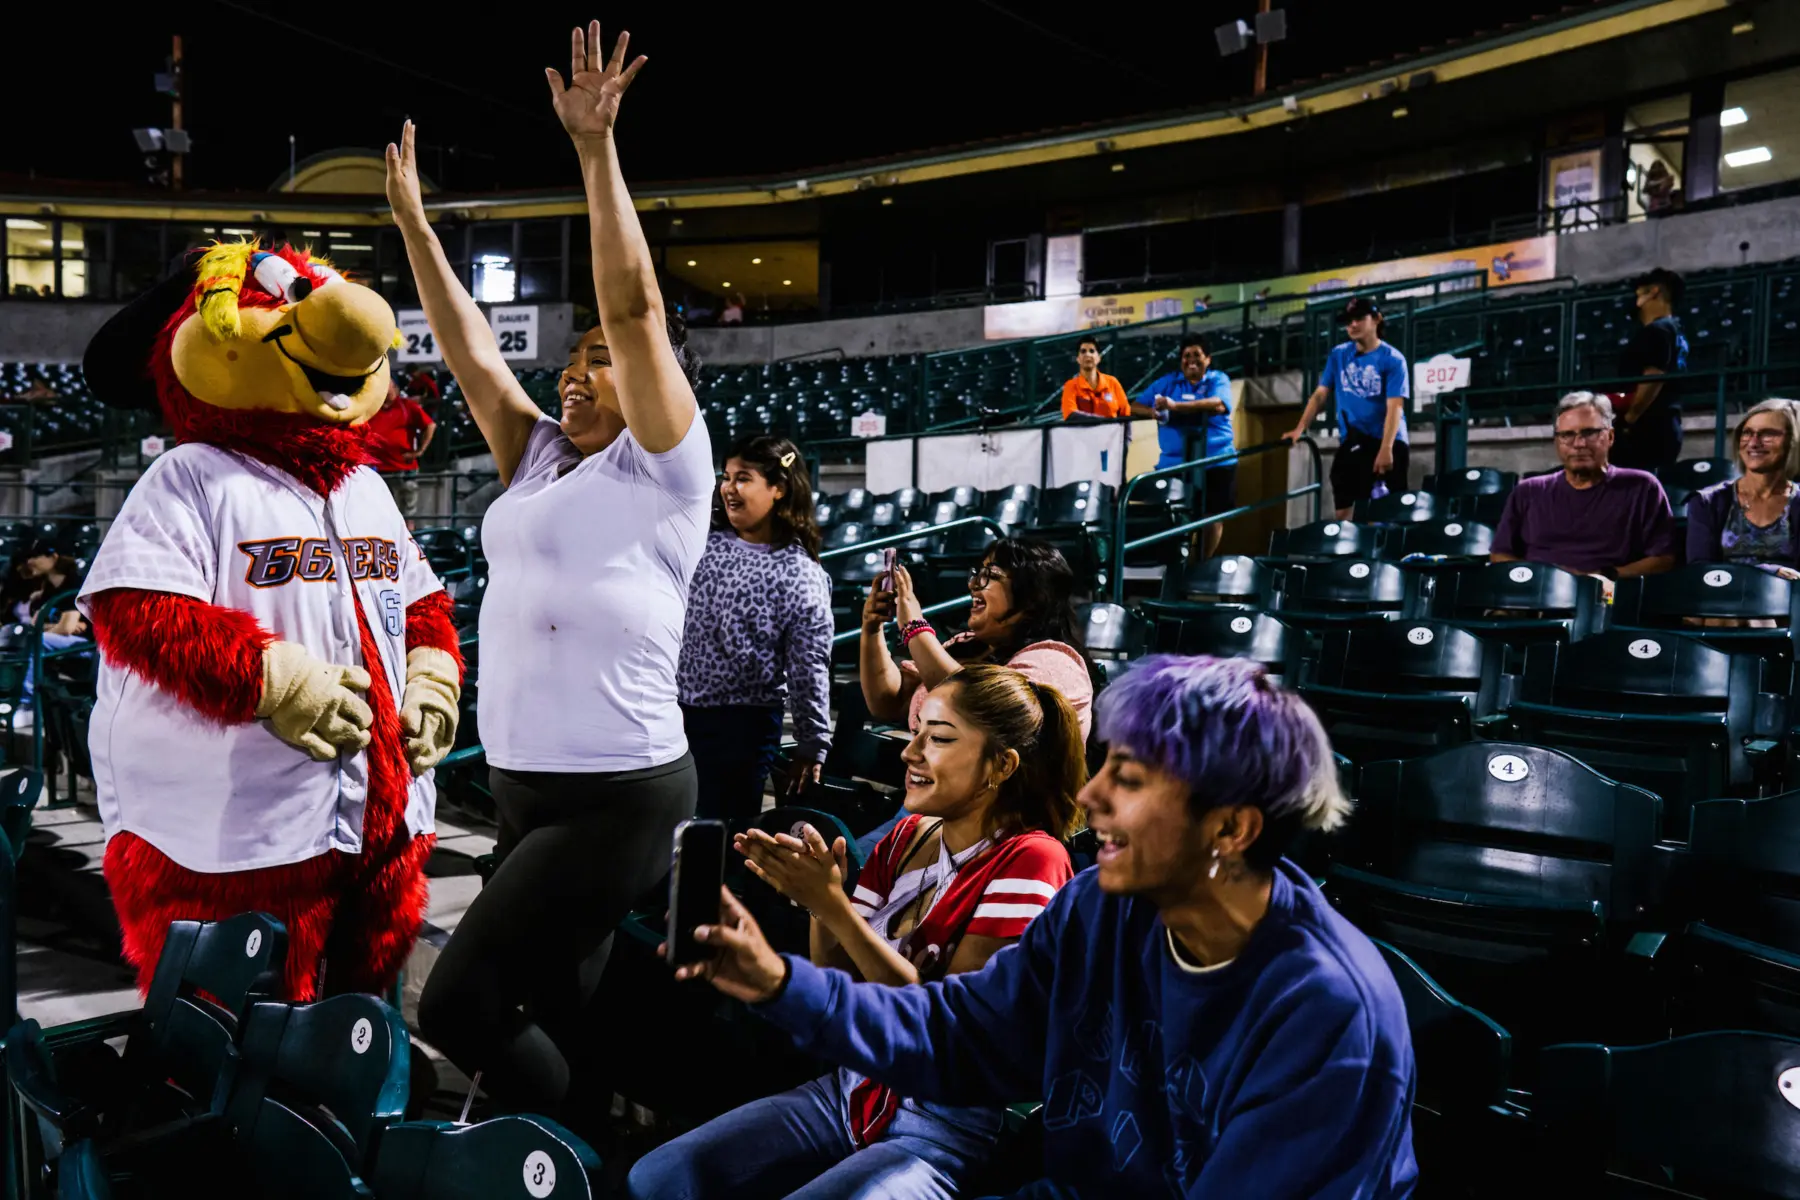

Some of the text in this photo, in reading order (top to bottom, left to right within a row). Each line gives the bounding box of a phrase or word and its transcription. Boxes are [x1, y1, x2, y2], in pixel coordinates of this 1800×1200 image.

[407, 333, 434, 354] 24
[500, 330, 527, 352] 25
[1426, 367, 1458, 383] 207
[238, 536, 399, 589] 66ERS
[1713, 574, 1721, 583] 4
[1416, 632, 1425, 641] 3
[1640, 644, 1650, 654] 4
[1502, 762, 1515, 775] 4
[250, 936, 258, 951] 1
[357, 1026, 366, 1045] 2
[533, 1162, 546, 1186] 3
